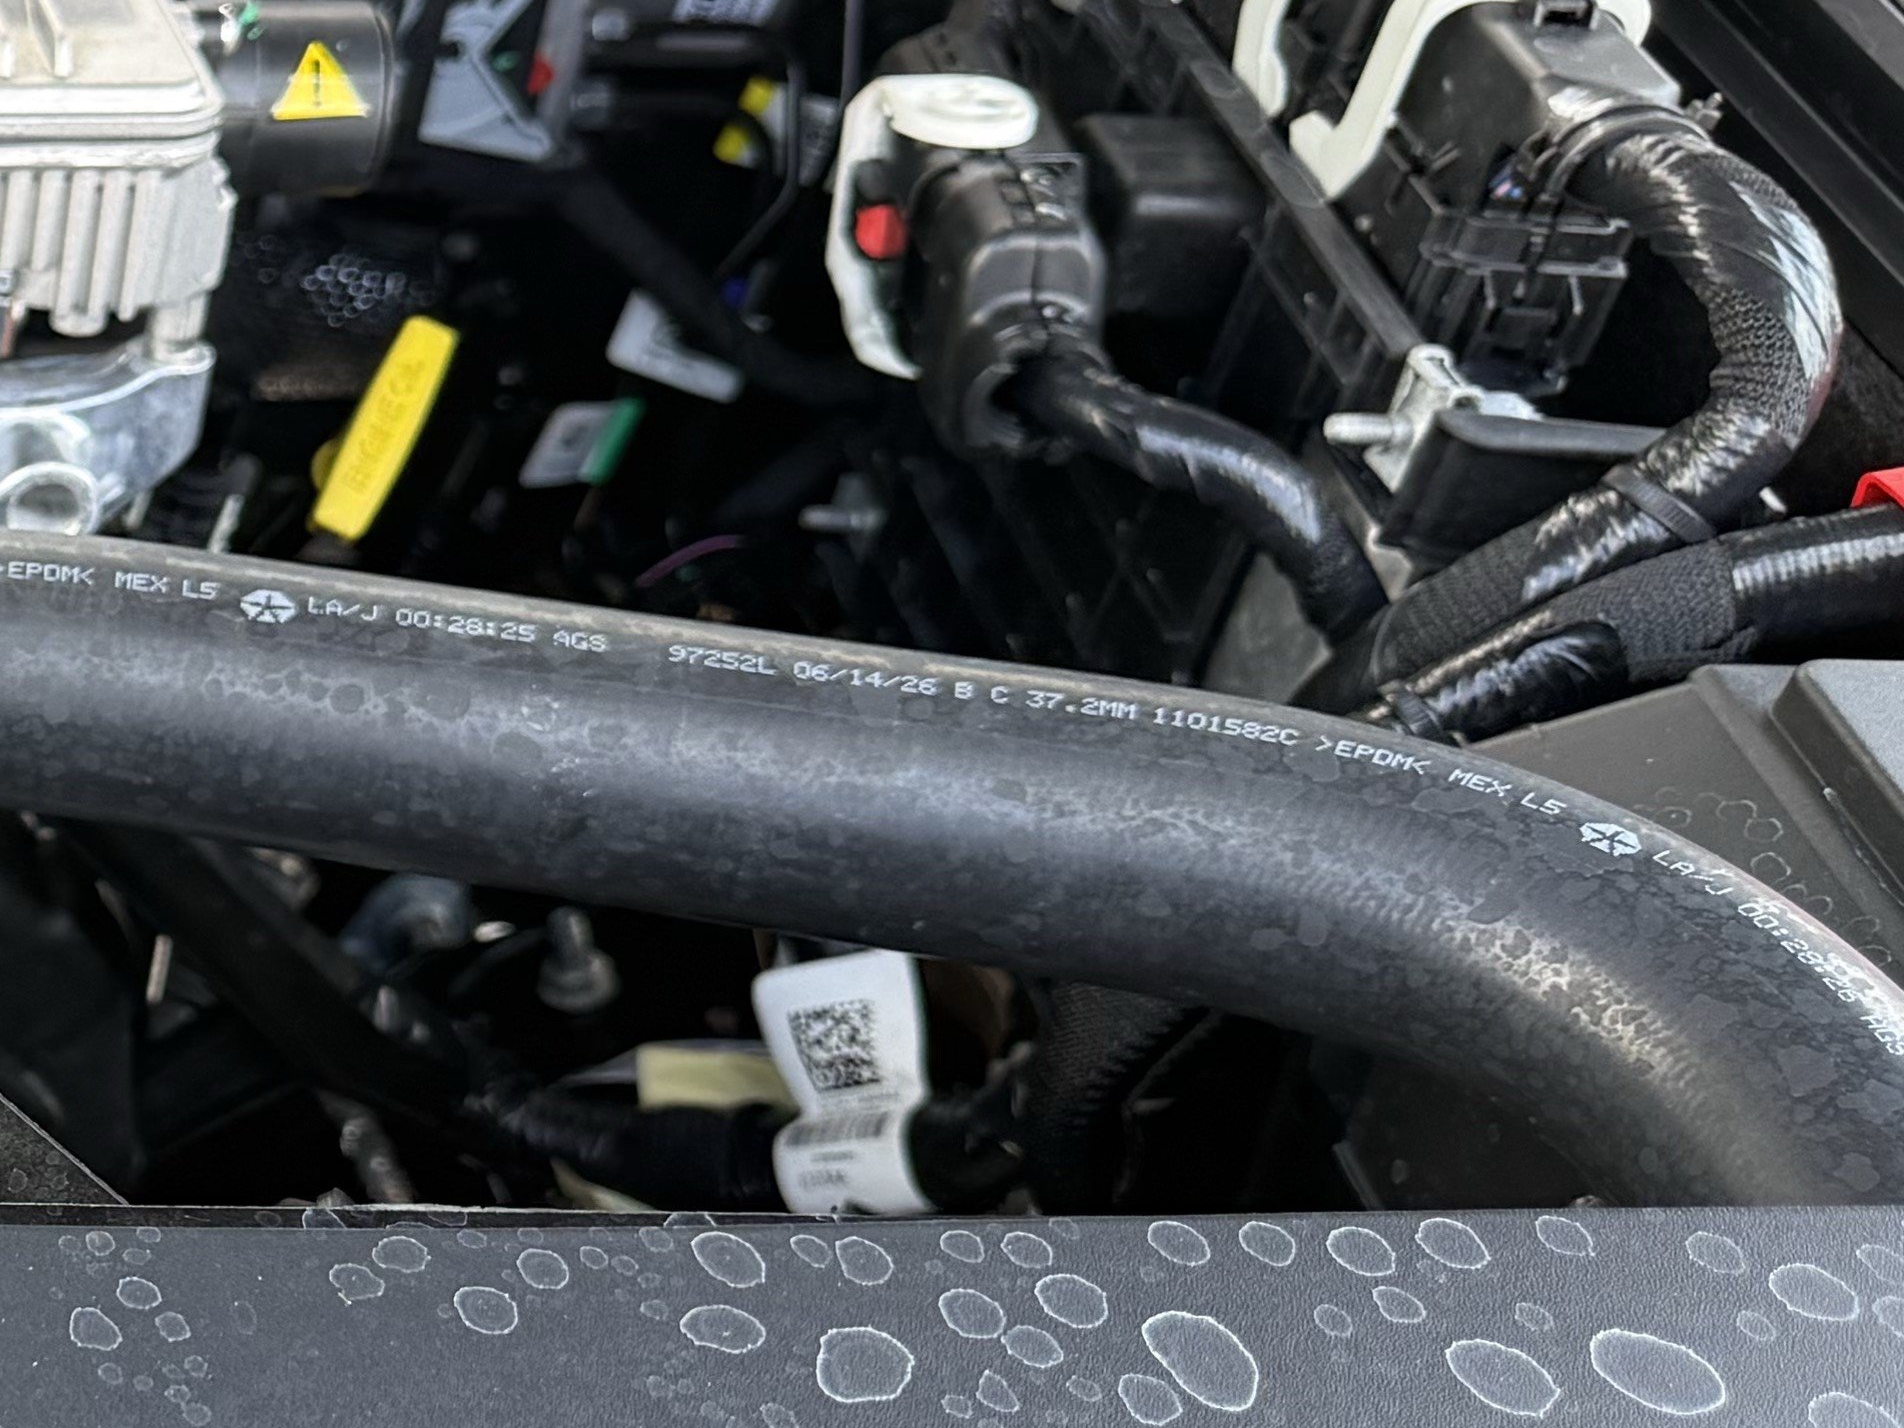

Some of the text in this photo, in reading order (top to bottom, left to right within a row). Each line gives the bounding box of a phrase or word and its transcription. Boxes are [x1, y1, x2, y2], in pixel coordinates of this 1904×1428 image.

[114, 570, 171, 594] MEX
[308, 596, 378, 621] LA/J
[395, 607, 537, 643] 00:28:25
[553, 629, 608, 653] AGS
[668, 644, 777, 676] 97252L
[793, 661, 941, 697] 06/14/26
[954, 681, 975, 700] B
[990, 685, 1009, 704] C
[1025, 690, 1139, 721] 37.2MM
[1153, 707, 1301, 746] 1101582C
[1448, 768, 1514, 798] MEX
